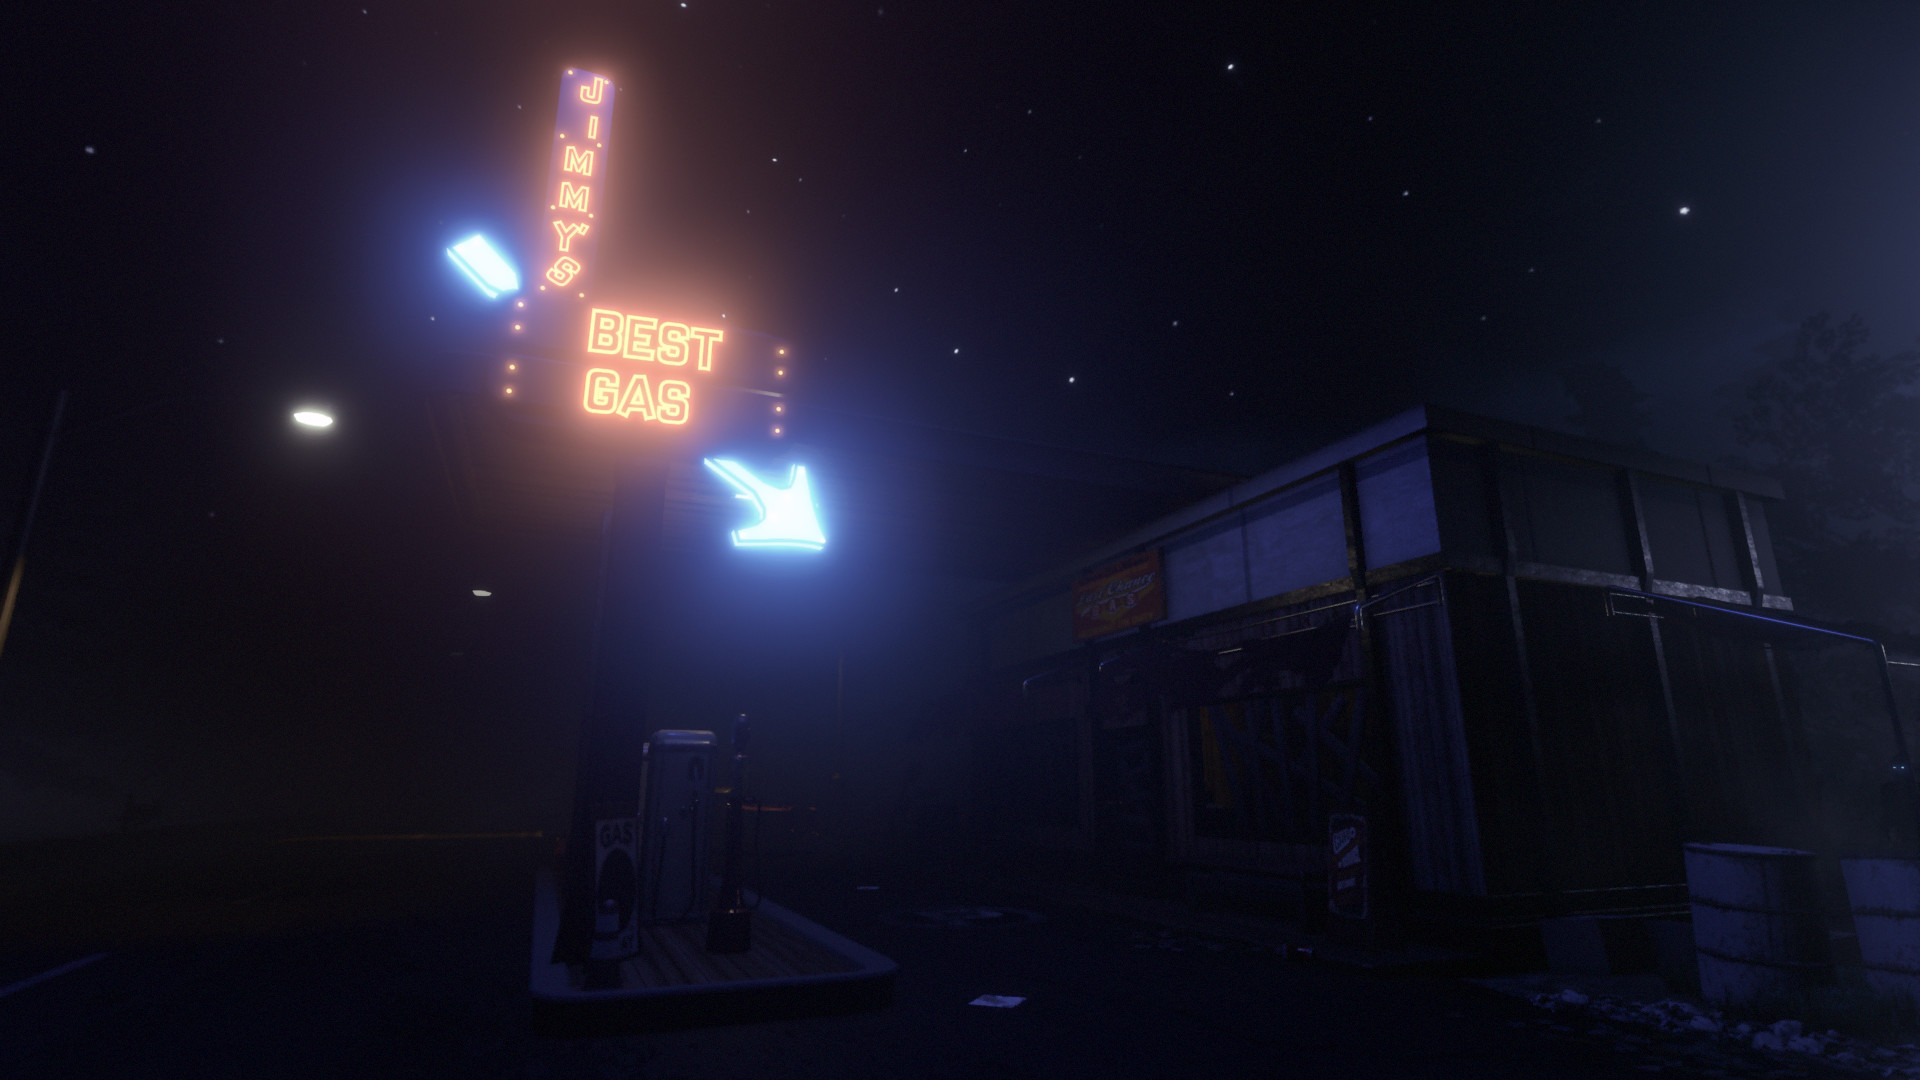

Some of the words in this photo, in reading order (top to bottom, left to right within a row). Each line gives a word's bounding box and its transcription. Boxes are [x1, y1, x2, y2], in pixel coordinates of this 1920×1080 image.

[546, 77, 604, 287] JIMMY'S
[588, 308, 724, 371] BEST
[583, 368, 690, 425] GAS
[600, 821, 633, 848] GAS
